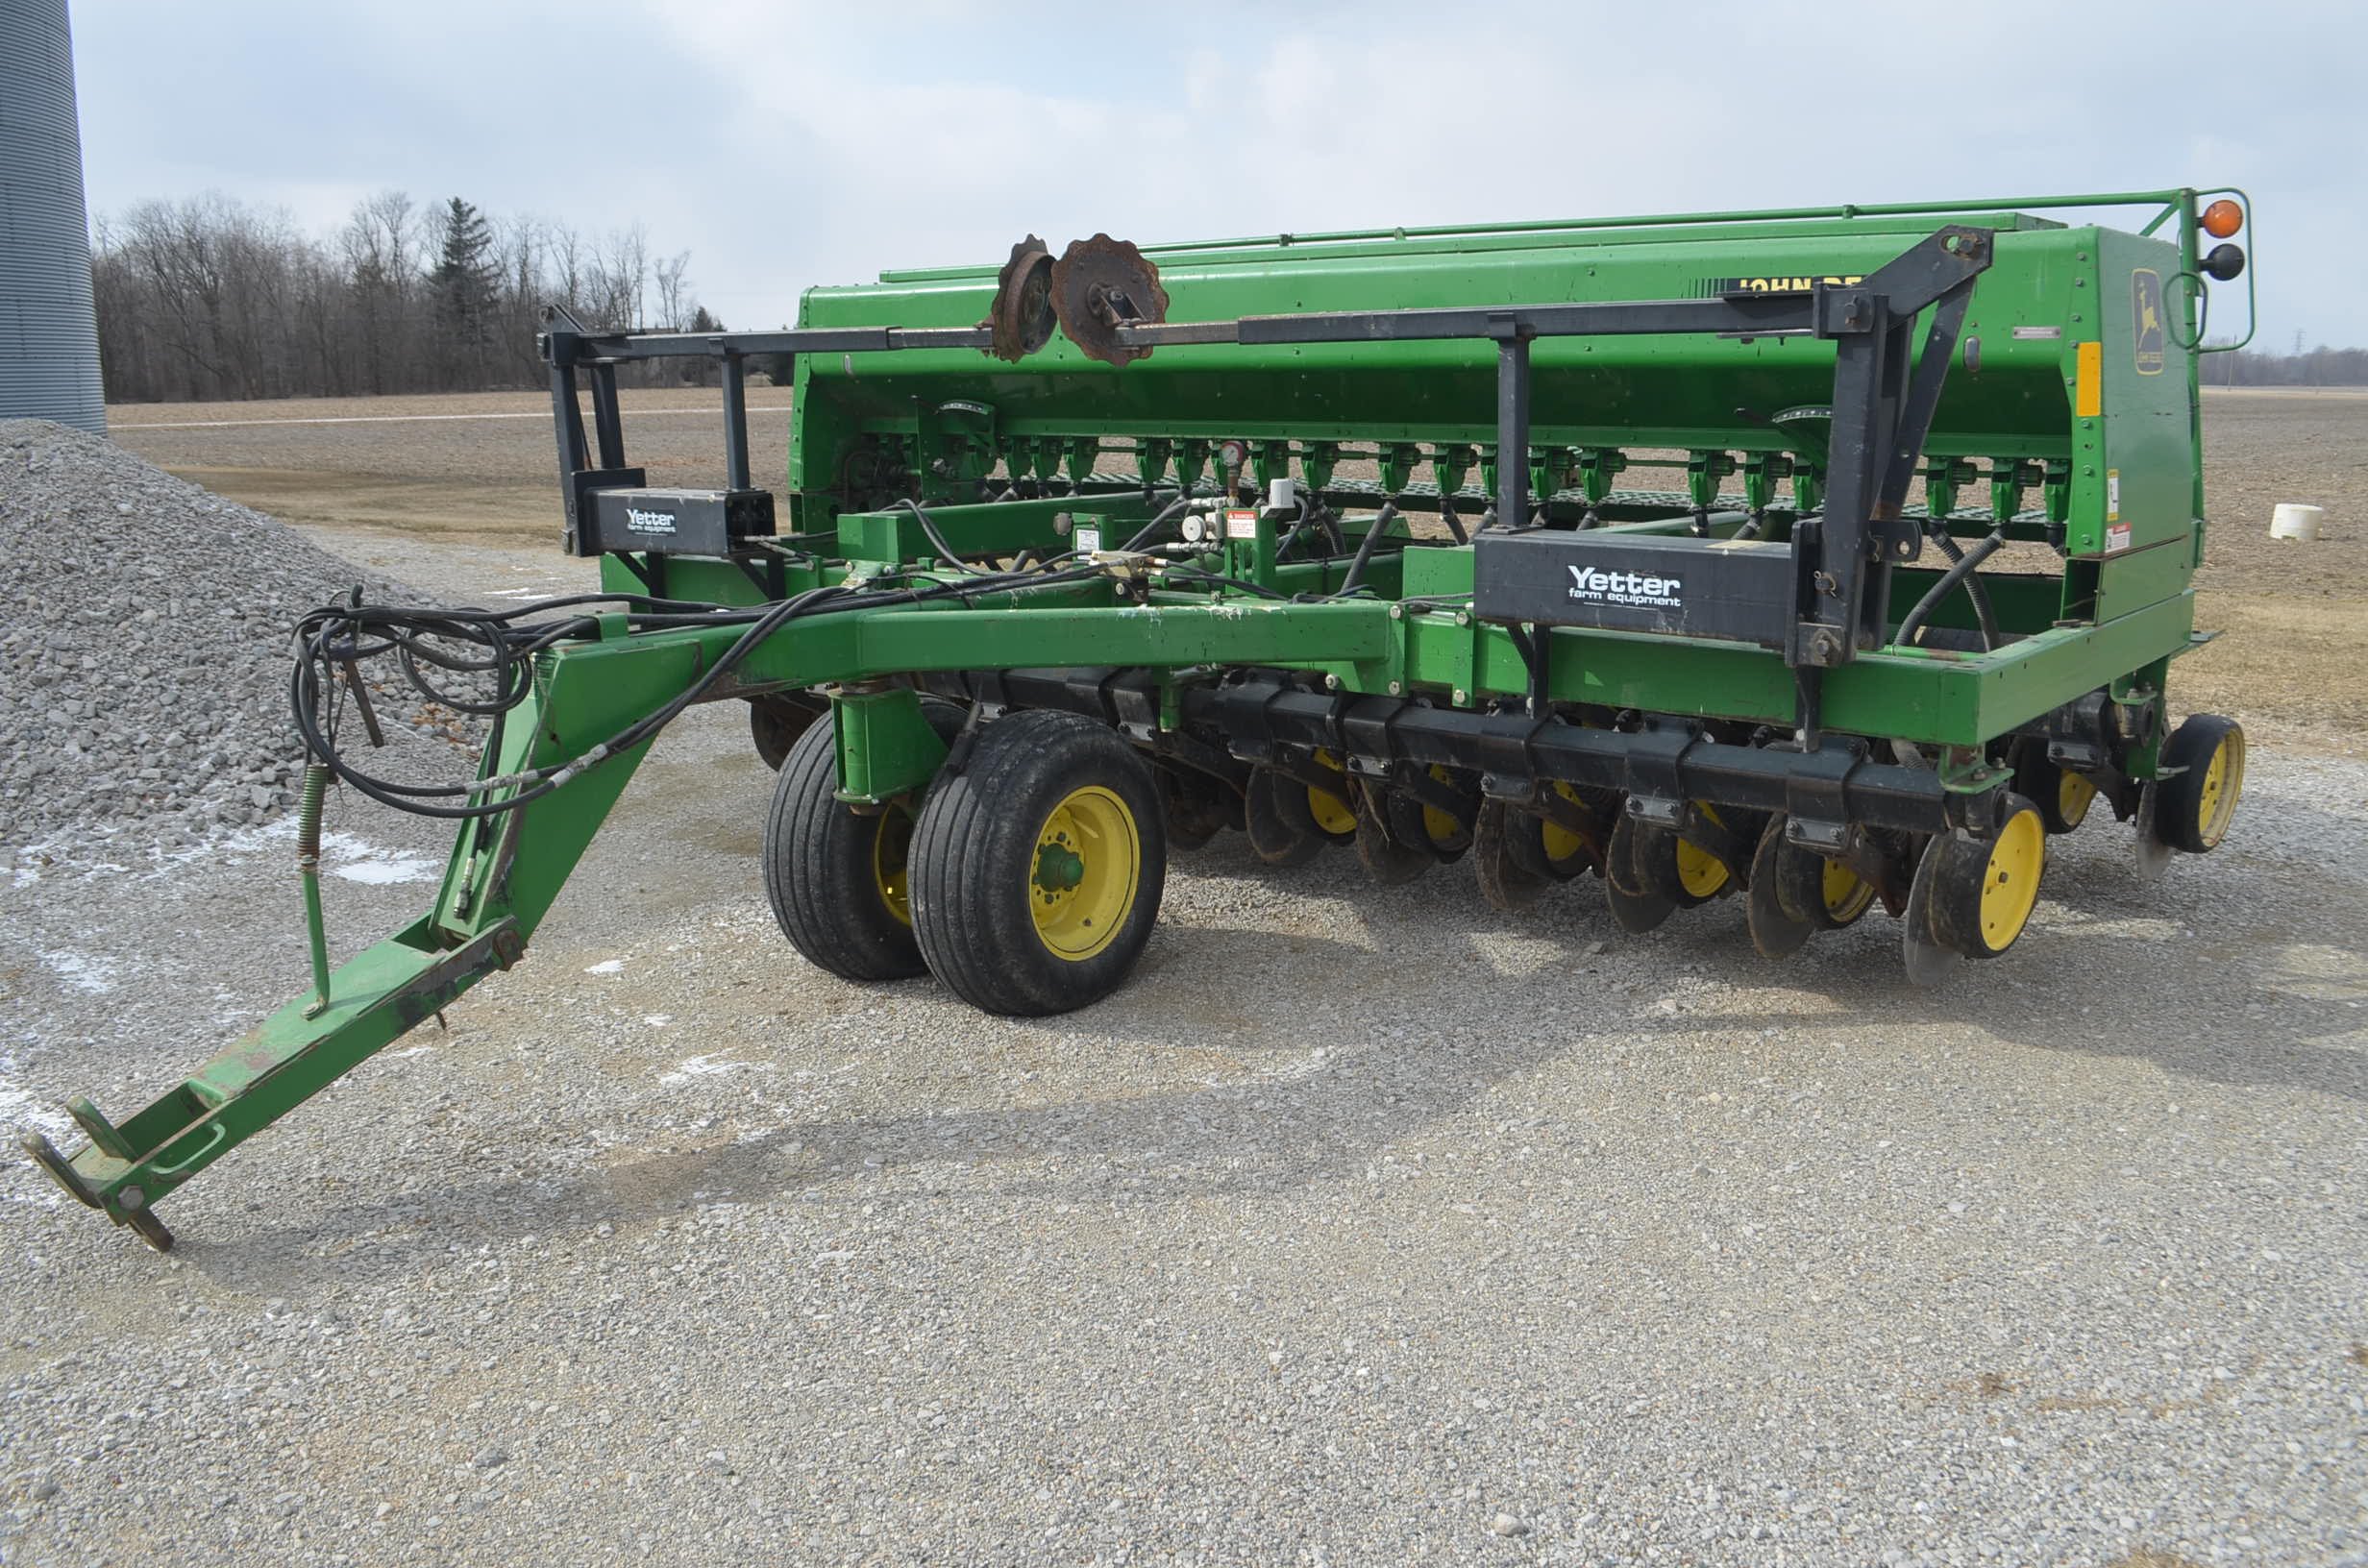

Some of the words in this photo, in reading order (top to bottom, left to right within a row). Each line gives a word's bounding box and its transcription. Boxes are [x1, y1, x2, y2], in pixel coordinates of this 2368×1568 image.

[626, 508, 675, 527] Yetter
[1567, 565, 1681, 596] Yetter
[1567, 587, 1602, 600] farm
[1607, 592, 1681, 607] equipment
